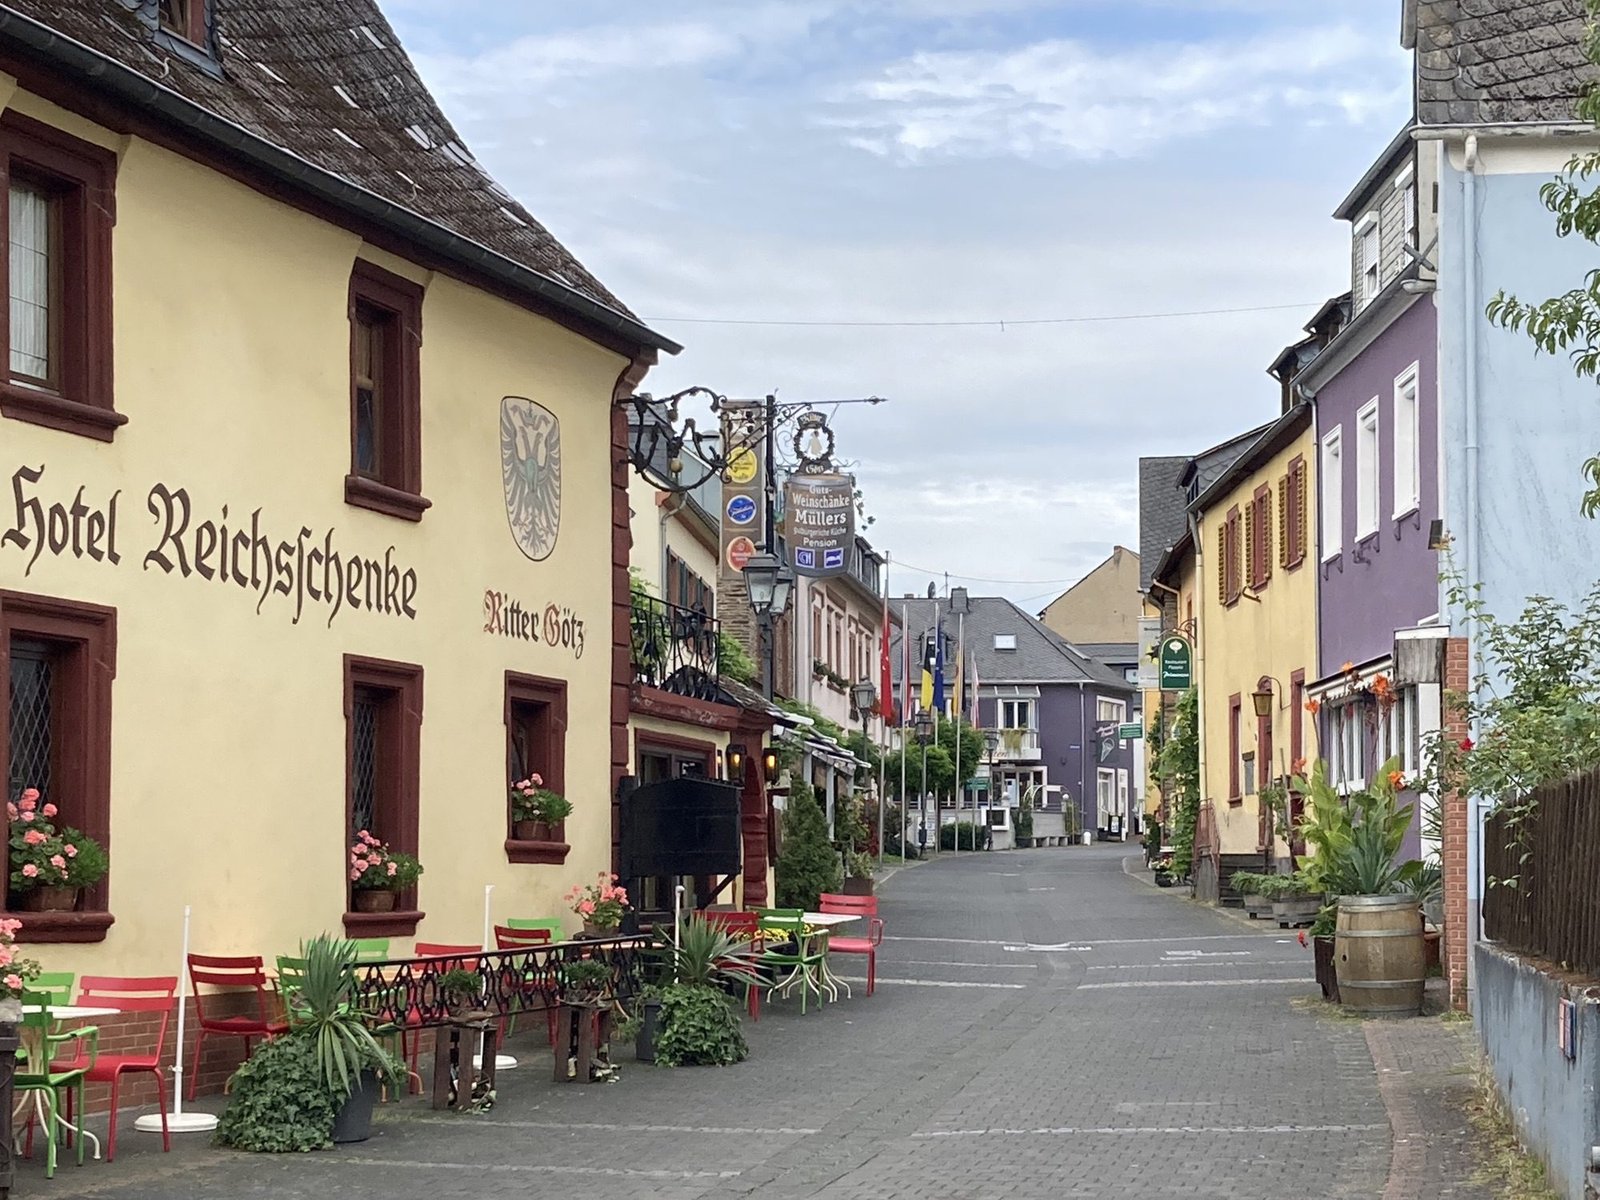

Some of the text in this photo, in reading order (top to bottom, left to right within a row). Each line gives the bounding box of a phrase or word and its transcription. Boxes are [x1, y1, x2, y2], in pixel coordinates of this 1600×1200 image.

[791, 492, 850, 508] Weinschänke
[1, 464, 122, 577] Hotel
[794, 508, 847, 526] Müllers
[802, 536, 837, 547] Pension
[483, 588, 584, 660] Ritter Götz
